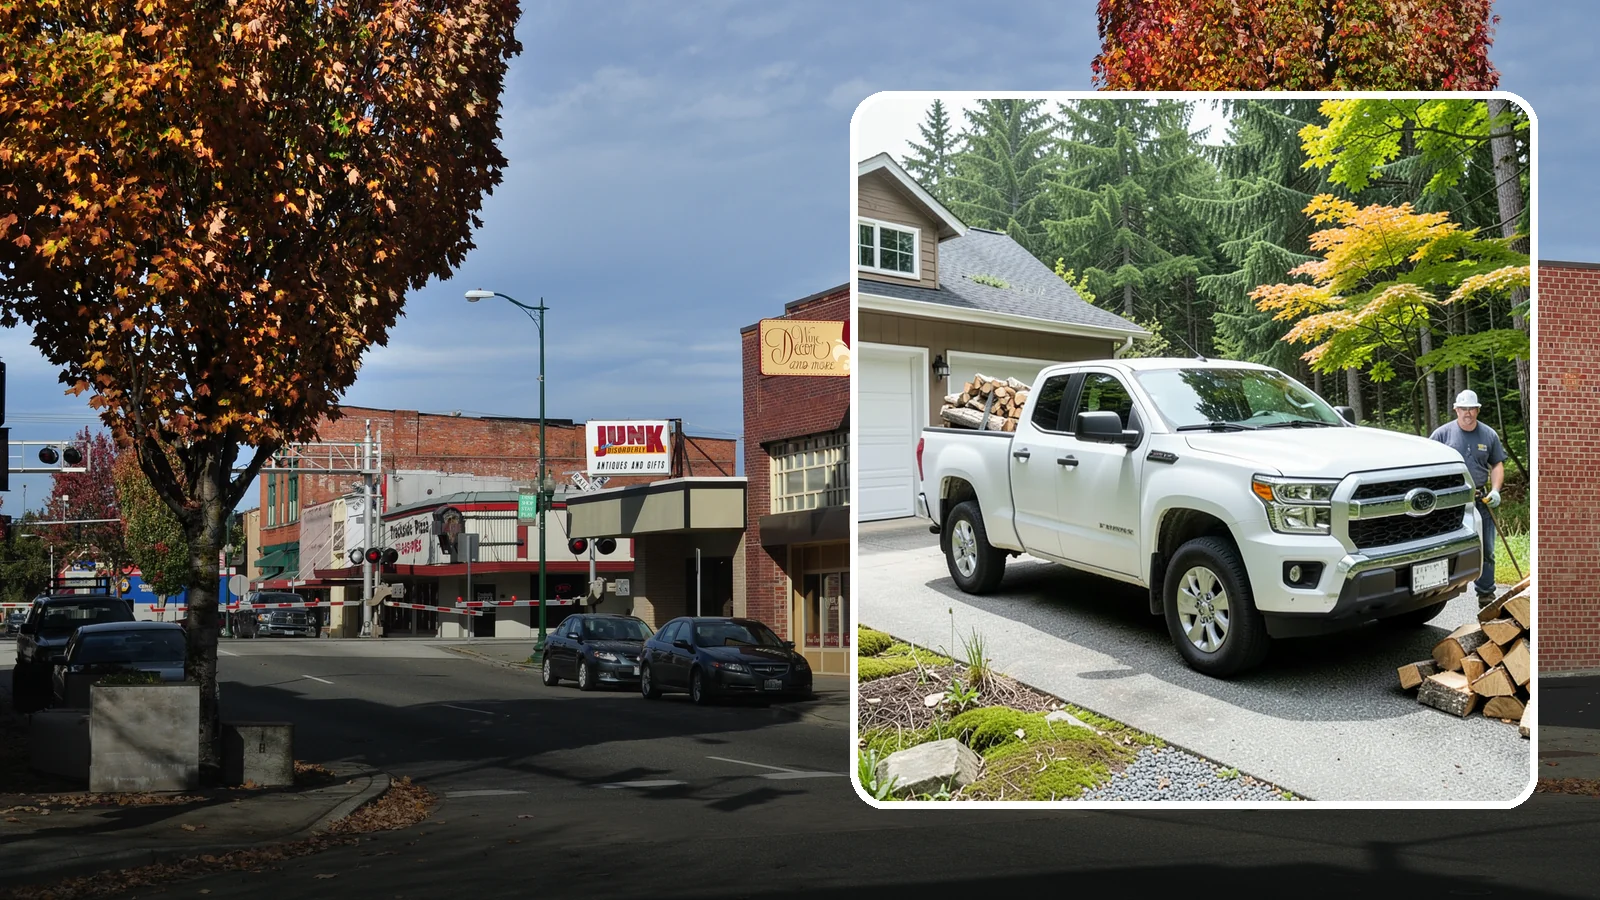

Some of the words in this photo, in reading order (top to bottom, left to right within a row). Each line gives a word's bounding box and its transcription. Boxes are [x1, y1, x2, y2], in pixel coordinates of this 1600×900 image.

[596, 425, 664, 457] JUNK
[607, 446, 645, 454] DISORDERLY
[597, 461, 628, 470] ANTIQUES
[631, 461, 644, 470] AND
[647, 460, 665, 469] GIFTS
[414, 519, 429, 535] Pizza
